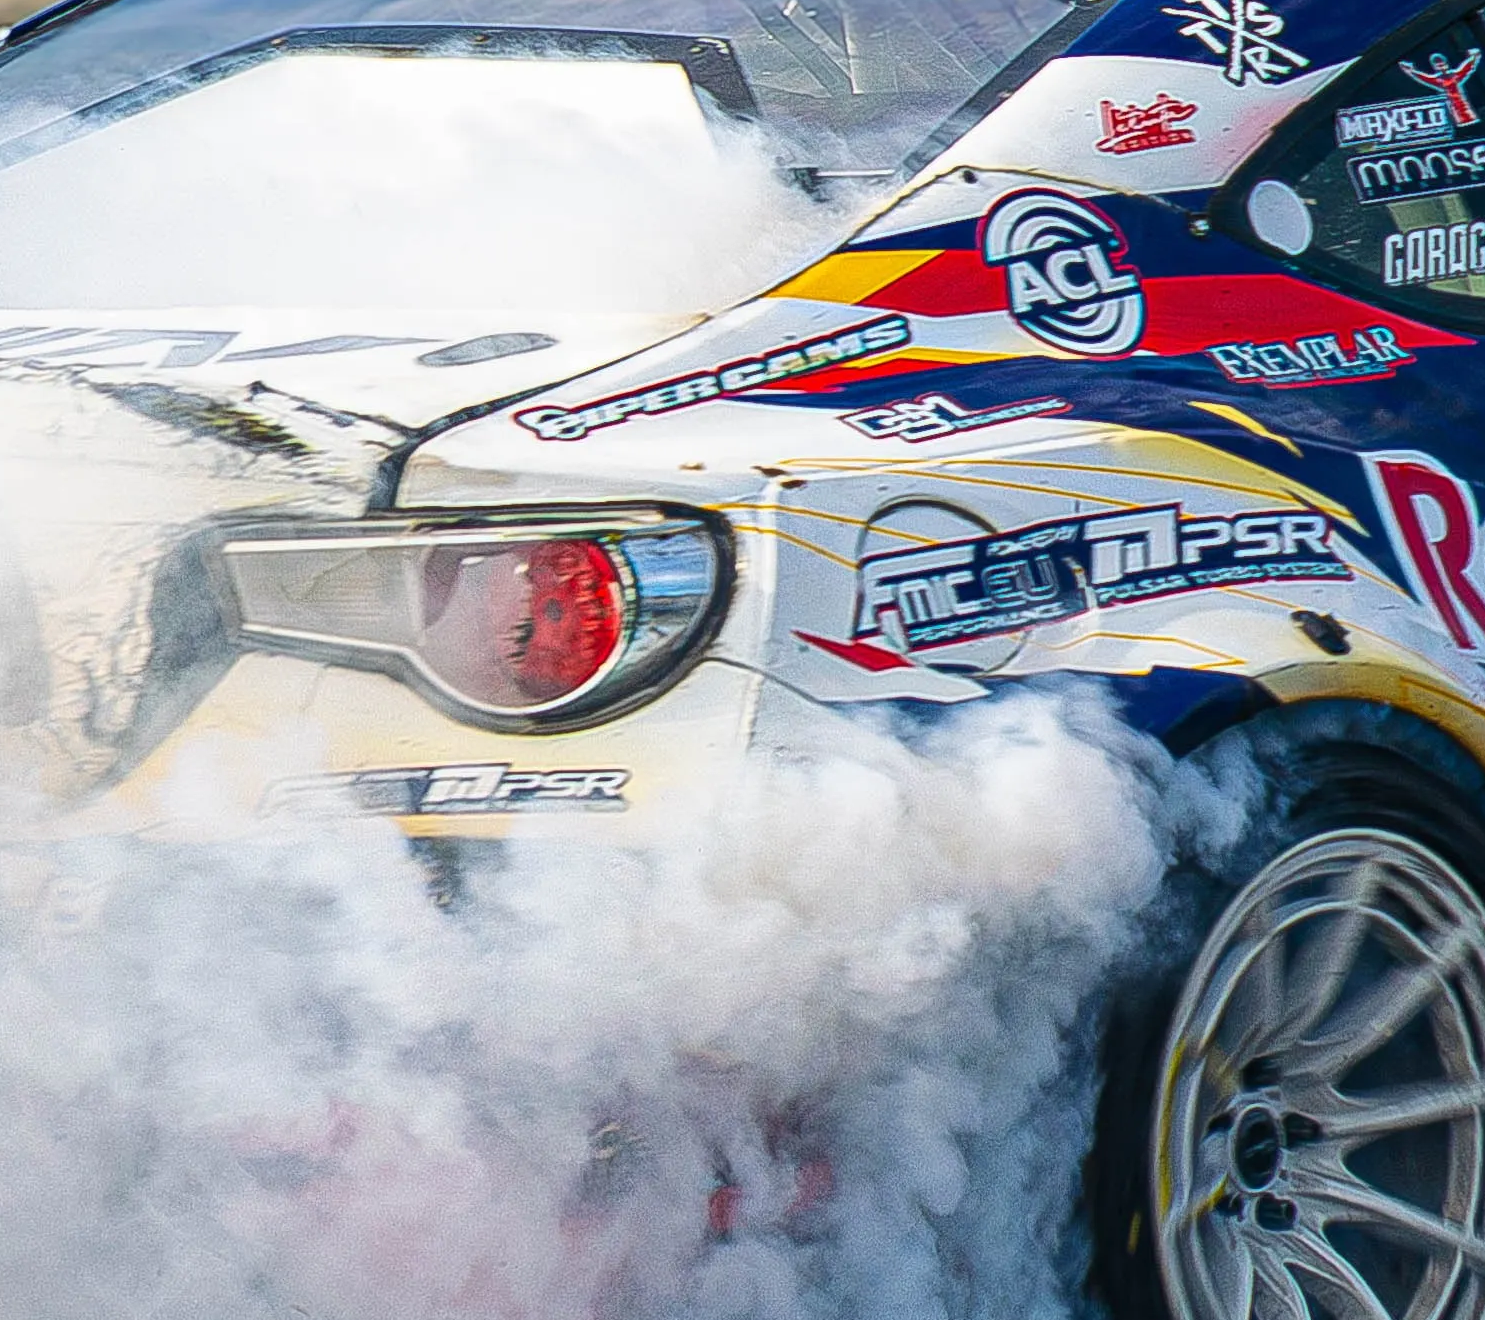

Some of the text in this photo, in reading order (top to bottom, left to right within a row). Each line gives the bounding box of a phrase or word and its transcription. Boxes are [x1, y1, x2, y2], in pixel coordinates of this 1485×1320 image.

[1009, 243, 1139, 313] ACL
[719, 319, 909, 392] CAMS
[1205, 327, 1411, 379] EXEMPLAR
[1180, 515, 1331, 564] PSR
[502, 770, 630, 798] PSR
